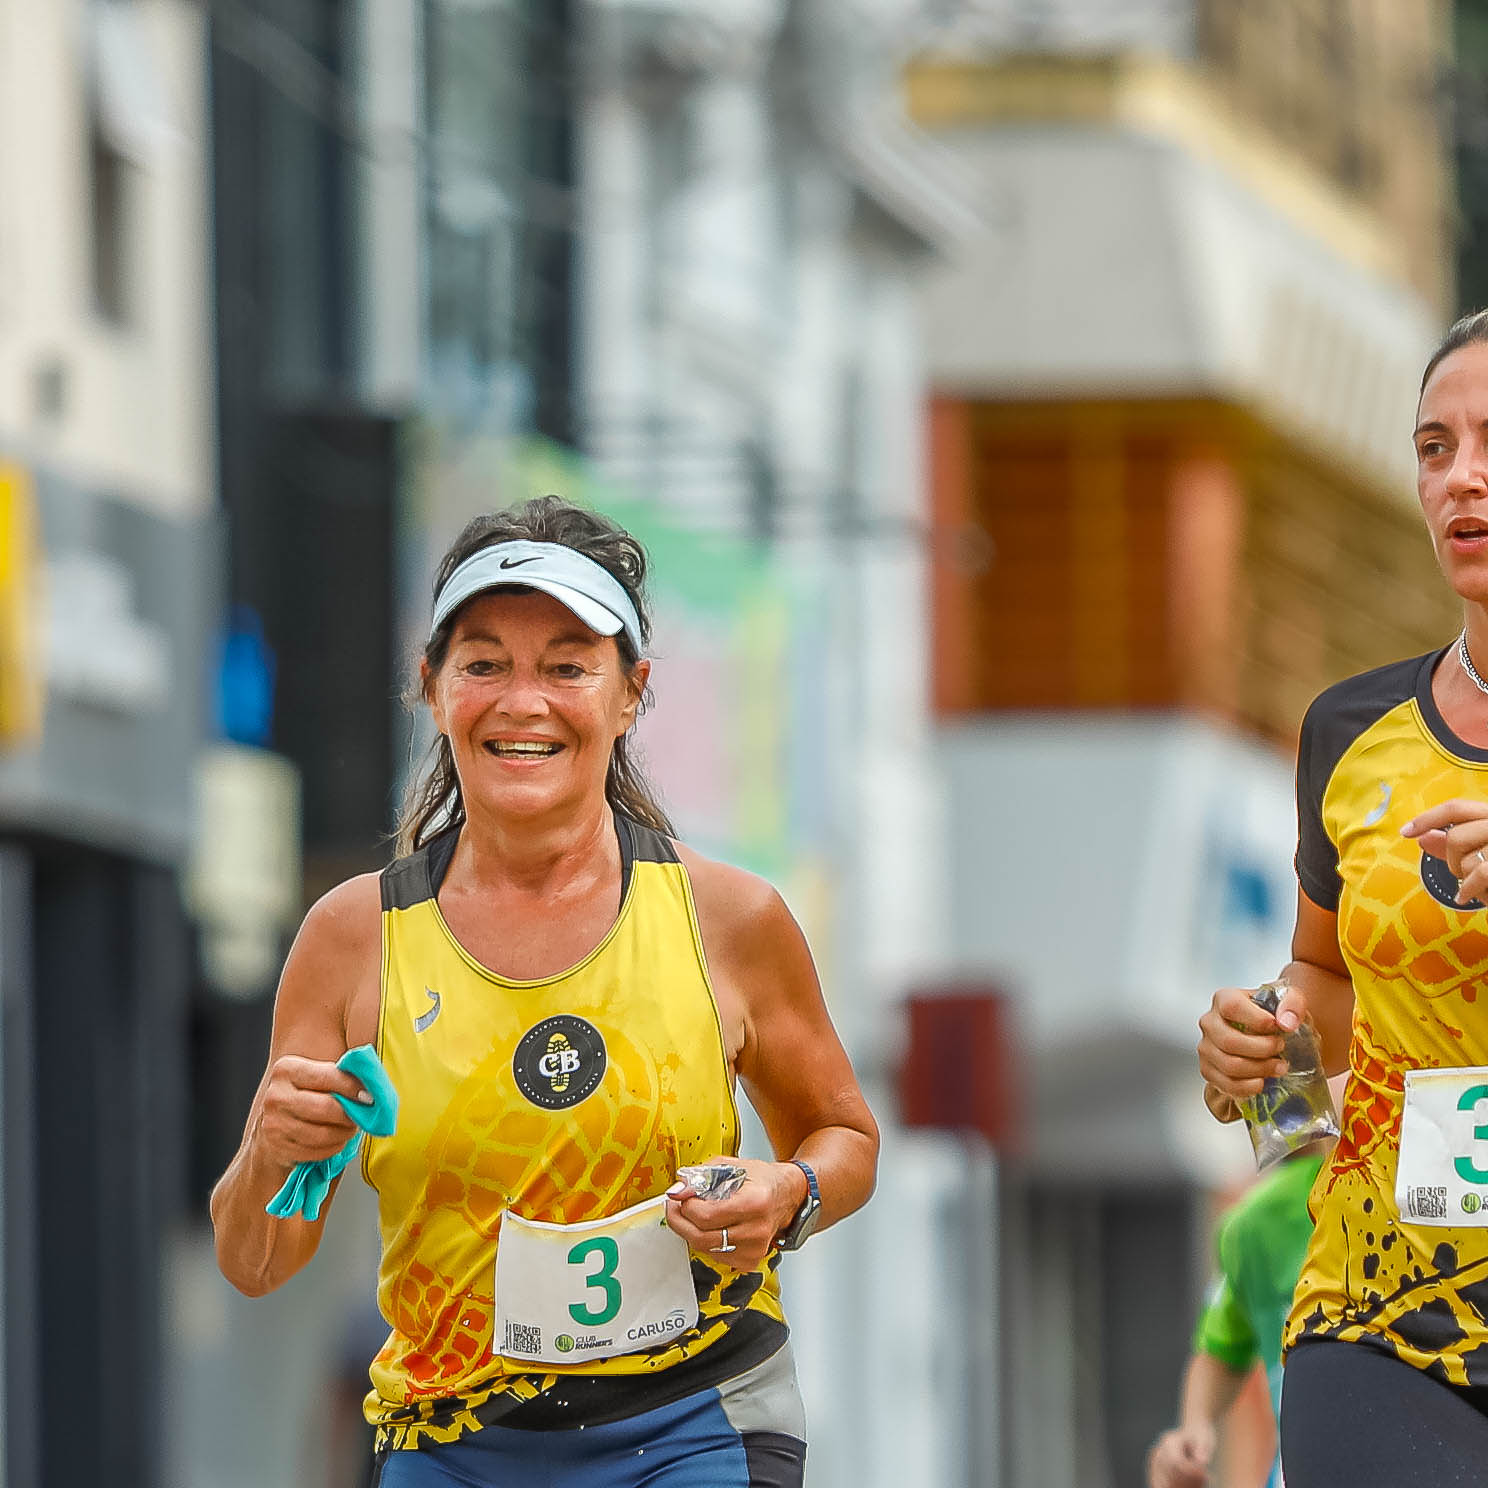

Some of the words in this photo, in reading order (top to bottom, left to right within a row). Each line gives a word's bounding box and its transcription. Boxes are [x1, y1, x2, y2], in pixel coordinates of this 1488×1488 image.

[538, 1049, 581, 1078] CB
[567, 1236, 623, 1327] 3
[627, 1317, 685, 1340] CARUSO
